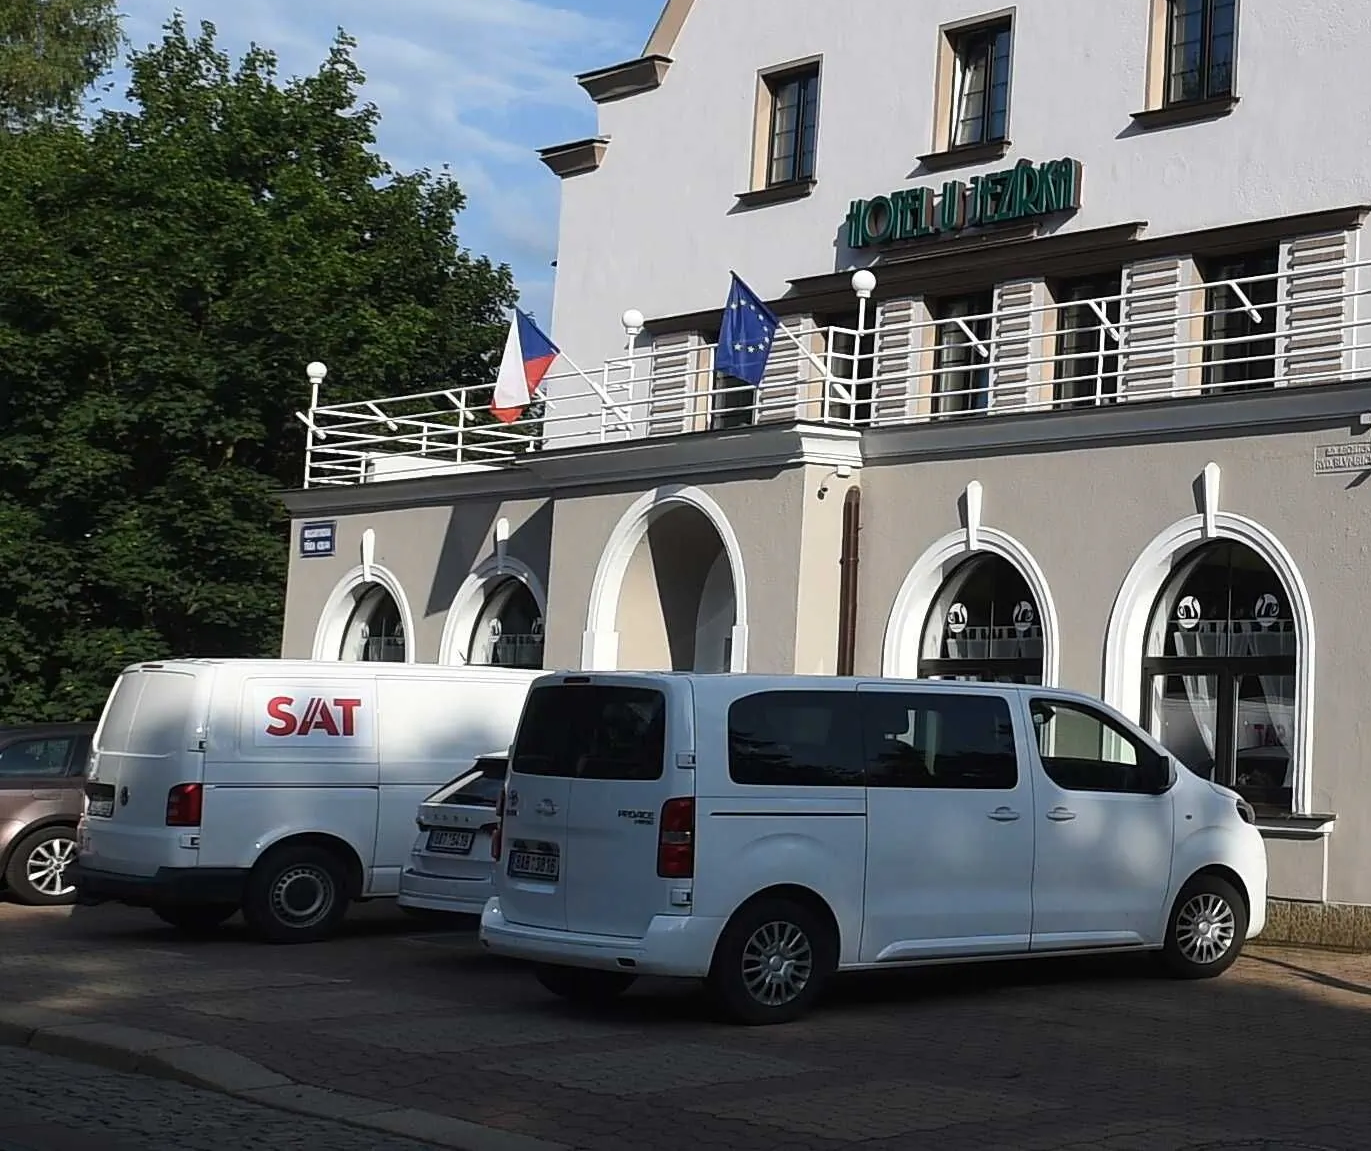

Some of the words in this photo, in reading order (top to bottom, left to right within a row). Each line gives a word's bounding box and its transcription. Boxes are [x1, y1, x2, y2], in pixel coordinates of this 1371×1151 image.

[847, 186, 934, 248] HOTEL
[941, 180, 965, 231] U
[265, 696, 361, 737] SAT
